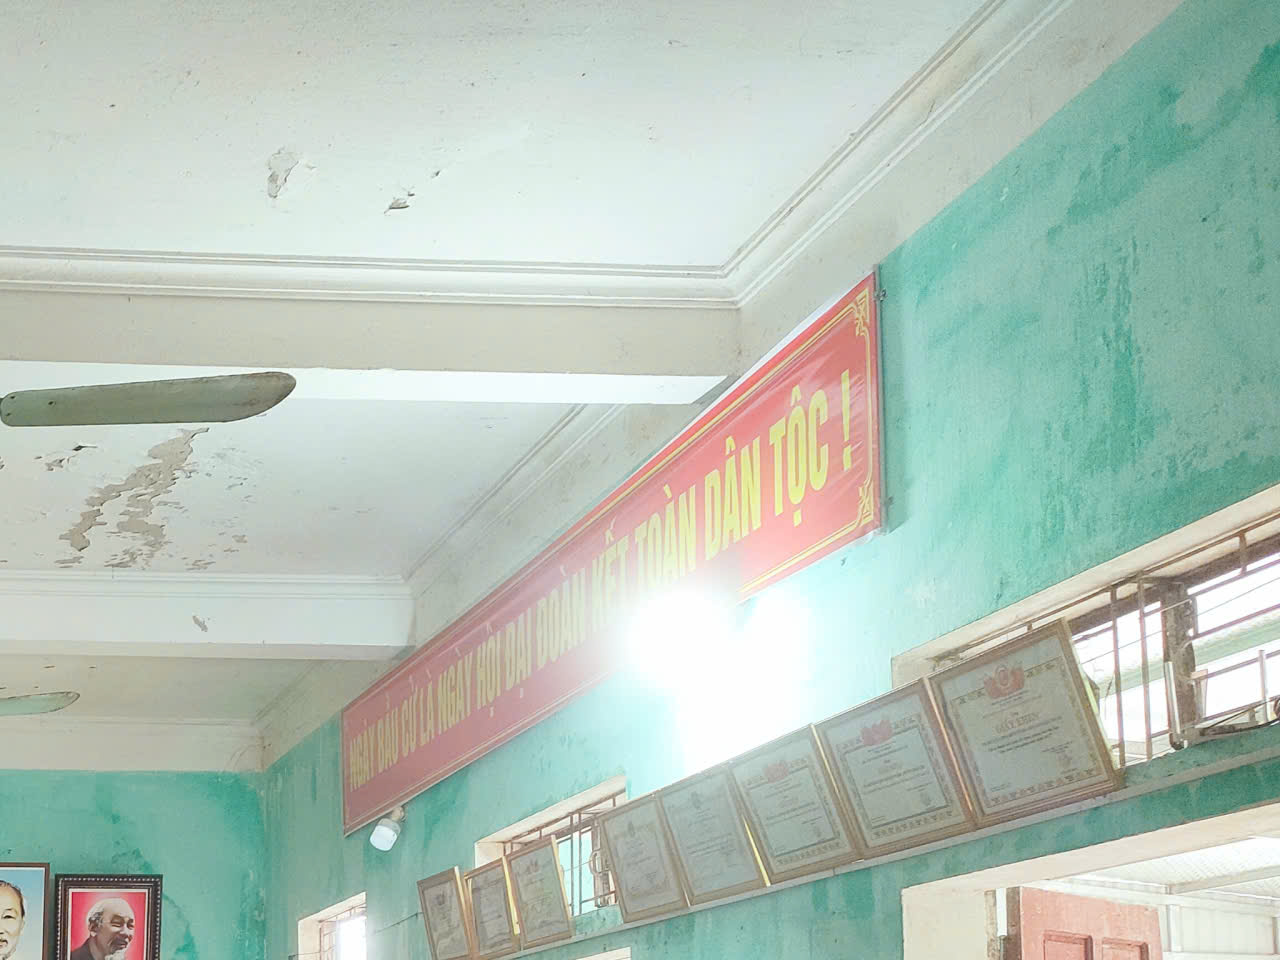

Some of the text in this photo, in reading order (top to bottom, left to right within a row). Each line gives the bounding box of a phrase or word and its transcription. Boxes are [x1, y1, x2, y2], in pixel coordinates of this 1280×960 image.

[419, 668, 435, 746] LÀ
[437, 647, 473, 735] NGÀY
[476, 623, 501, 718] HỘI
[505, 608, 532, 698] ĐẠI
[535, 565, 586, 670] ĐOÀN
[591, 516, 629, 638] KẾT
[635, 484, 696, 598] TOÀN
[704, 435, 762, 560] DÂN
[769, 385, 828, 527] TỘC
[841, 368, 852, 472] !
